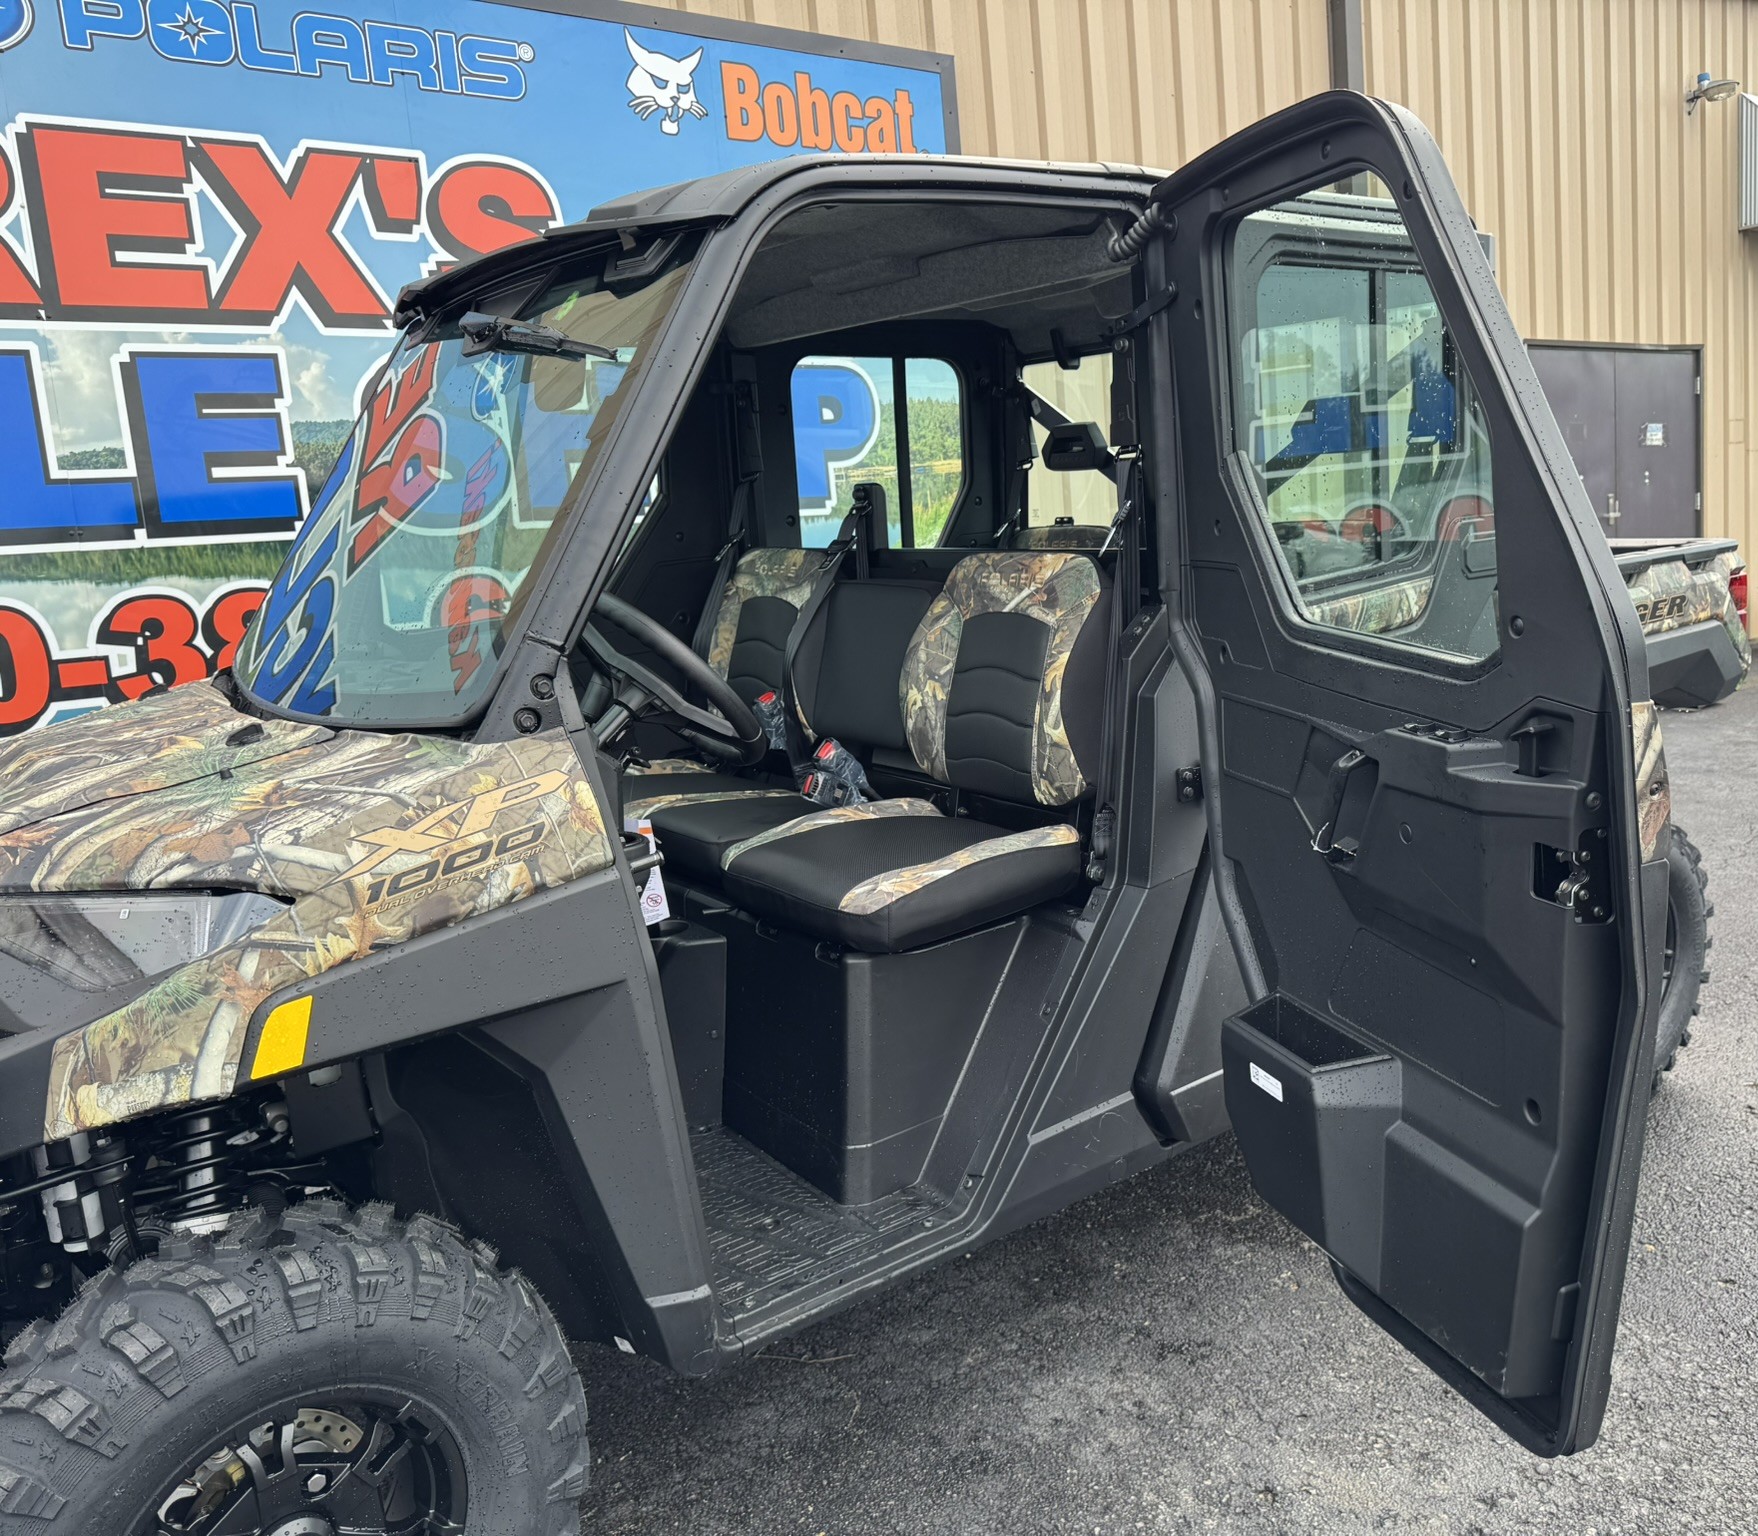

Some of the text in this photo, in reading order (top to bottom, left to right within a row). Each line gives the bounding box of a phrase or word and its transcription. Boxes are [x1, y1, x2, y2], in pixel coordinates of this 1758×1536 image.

[720, 60, 917, 153] Bobcat
[0, 121, 556, 326] EX'S
[319, 768, 572, 891] XP
[363, 820, 551, 908] 1000
[364, 844, 546, 920] DUAL OVERHEAD CAM
